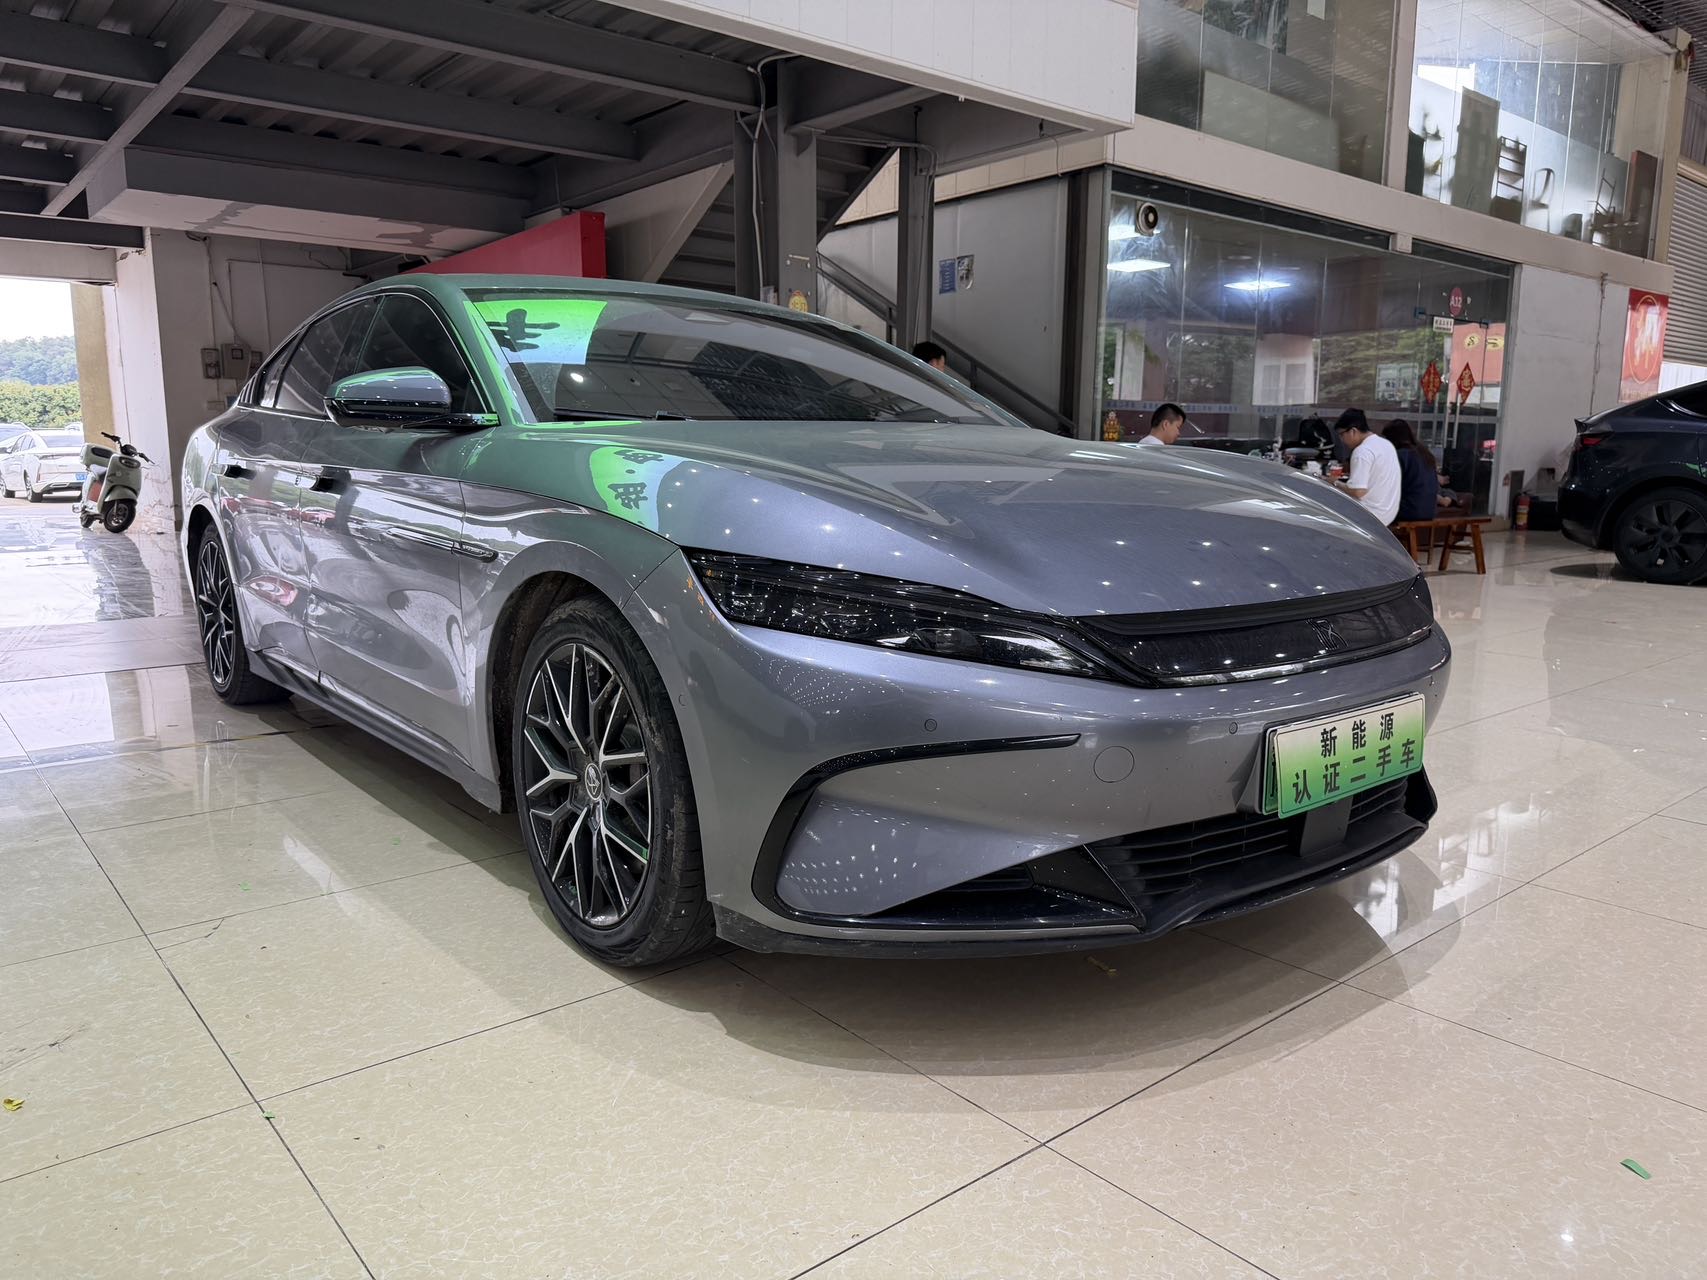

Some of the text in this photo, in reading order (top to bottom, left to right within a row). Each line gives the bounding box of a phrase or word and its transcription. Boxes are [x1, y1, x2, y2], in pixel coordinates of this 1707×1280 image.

[1320, 712, 1394, 758] 新能源
[1292, 738, 1416, 804] 认证二手车
